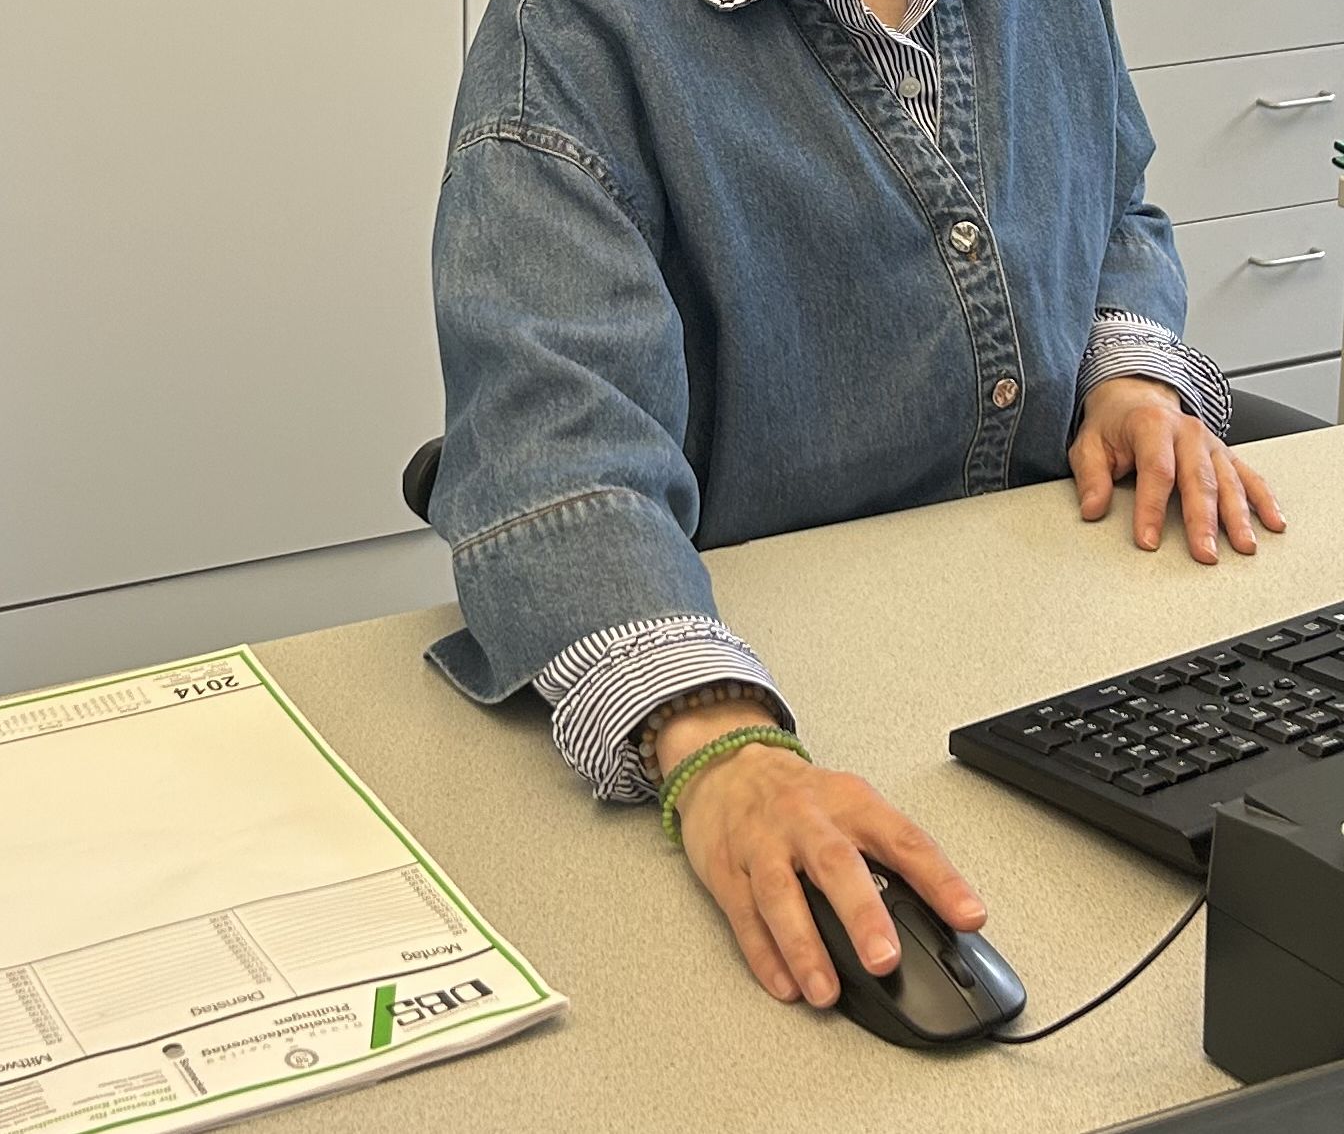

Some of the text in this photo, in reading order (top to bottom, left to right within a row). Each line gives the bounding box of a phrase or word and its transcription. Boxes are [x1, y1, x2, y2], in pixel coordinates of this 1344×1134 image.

[173, 675, 240, 700] 2014
[400, 942, 463, 962] Montag
[189, 989, 266, 1018] Dienstag
